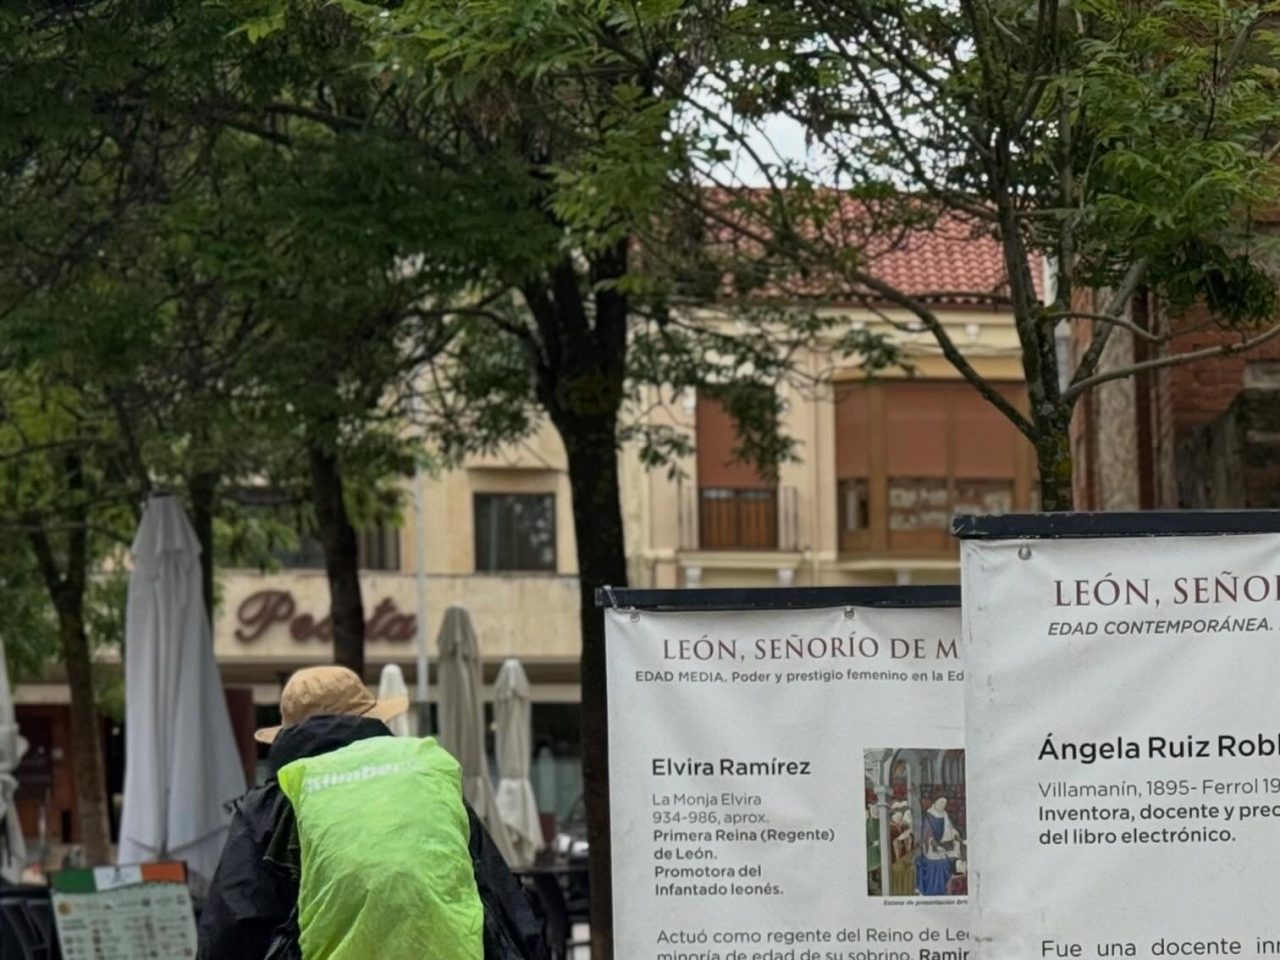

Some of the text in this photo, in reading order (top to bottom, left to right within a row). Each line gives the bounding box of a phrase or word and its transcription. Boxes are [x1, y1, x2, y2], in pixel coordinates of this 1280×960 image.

[1054, 572, 1160, 608] LEÓN,
[1047, 621, 1098, 636] EDAD
[1103, 615, 1273, 635] CONTEMPORÁNEA.
[663, 634, 745, 662] LEÓN,
[754, 631, 879, 660] SEÑORÍO
[889, 638, 926, 659] DE
[635, 668, 943, 684] EDAD MEDIA. Poder y prestigio femenino en la
[1037, 732, 1140, 764] Ángela
[1148, 734, 1210, 759] Ruiz
[652, 757, 811, 776] Elvira Ramírez
[1037, 780, 1142, 798] Villamanín,
[1146, 779, 1197, 796] 1895-
[1202, 777, 1258, 795] Ferrol
[652, 792, 762, 808] La Monja Elvira
[652, 810, 770, 826] 934-986, aprox.
[1039, 805, 1135, 822] Inventora,
[1139, 803, 1219, 820] docente
[1223, 805, 1235, 821] y
[653, 828, 835, 843] Primera Reina (Regente)
[1038, 826, 1236, 845] del libro electrónico.
[653, 846, 717, 860] de León.
[654, 864, 761, 878] Promotora del
[655, 882, 784, 896] Infantado leonés.
